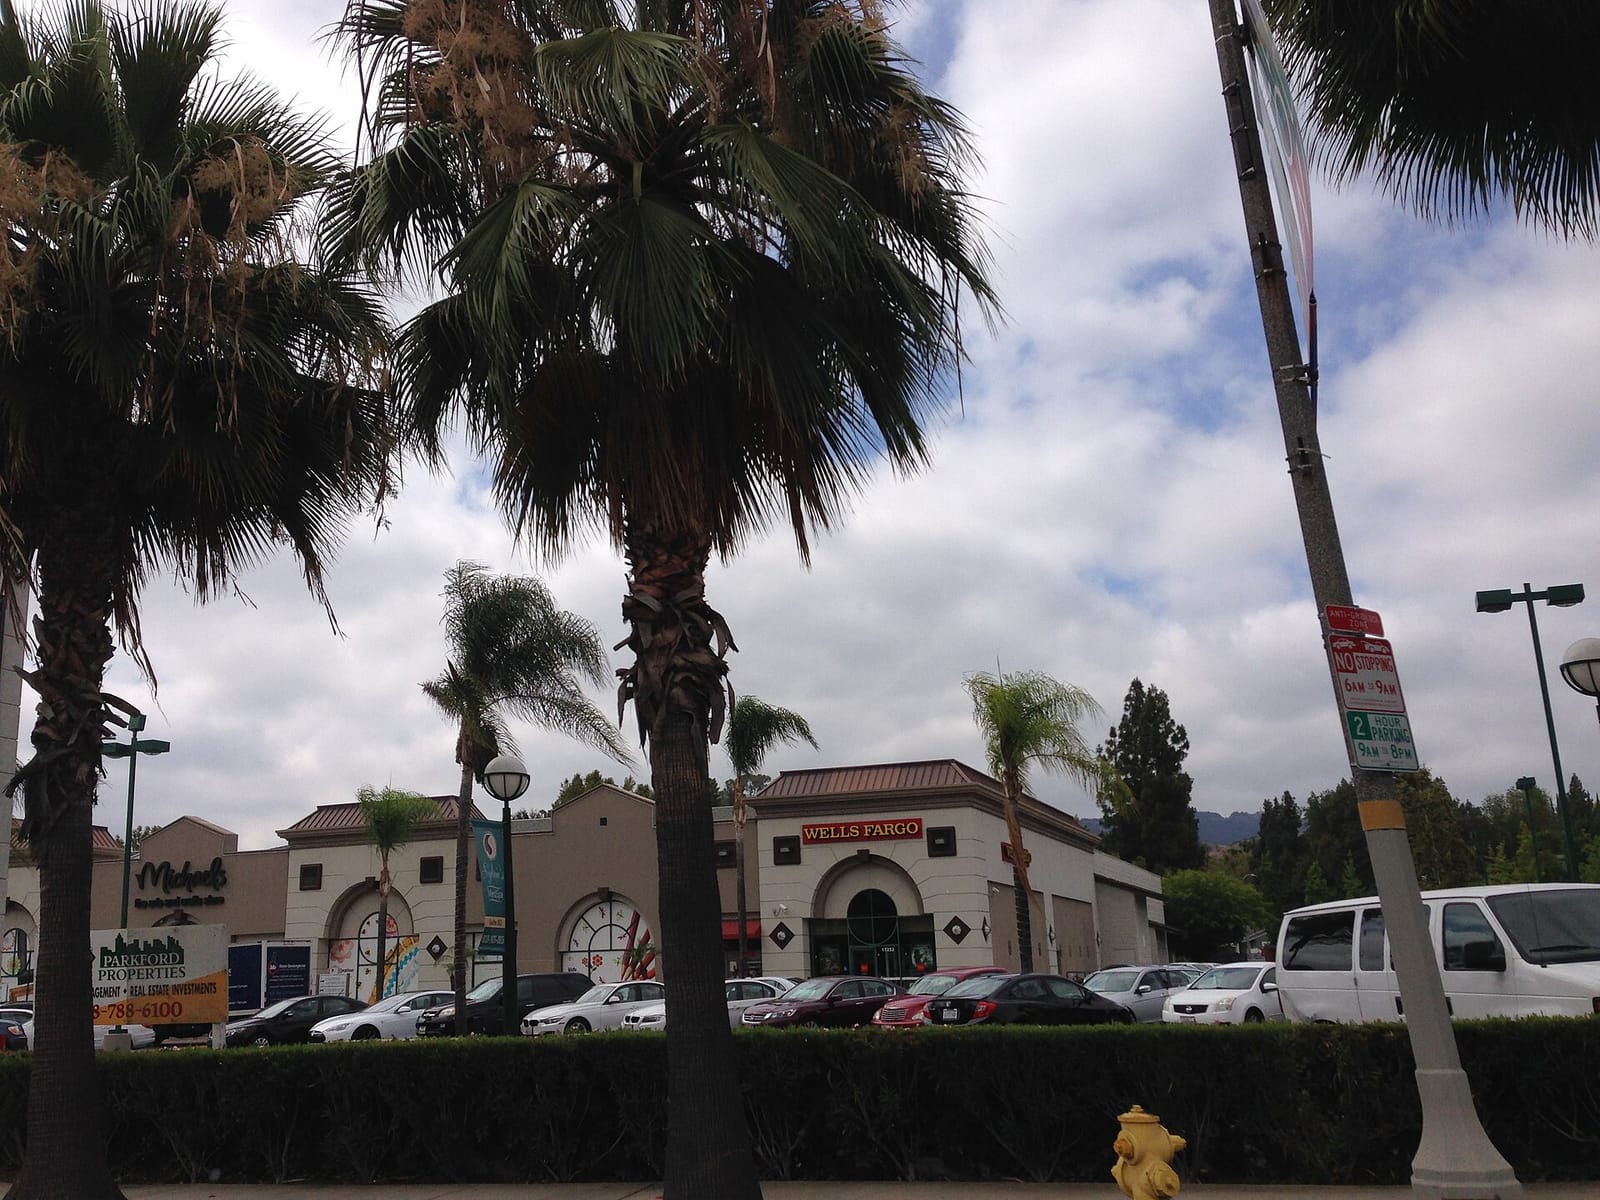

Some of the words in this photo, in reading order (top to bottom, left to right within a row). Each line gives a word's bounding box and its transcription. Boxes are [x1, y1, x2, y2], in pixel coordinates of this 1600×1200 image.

[1334, 652, 1354, 671] NO
[1355, 655, 1394, 672] STOPPING
[1345, 678, 1365, 692] 6AM
[1375, 680, 1397, 695] 9AM
[1354, 716, 1366, 736] 2
[1374, 716, 1401, 727] HOUR
[1371, 726, 1411, 743] PARKING
[1358, 742, 1380, 758] 9AM
[1391, 744, 1412, 760] 8PM
[804, 825, 860, 840] WELLS
[863, 822, 919, 837] FARGO
[135, 857, 227, 894] Michaels
[103, 952, 181, 967] PARKFORD
[98, 966, 186, 981] PROPERTIES
[129, 984, 146, 997] REAL
[148, 984, 169, 996] ESTATE
[172, 982, 217, 995] INVESTMENTS
